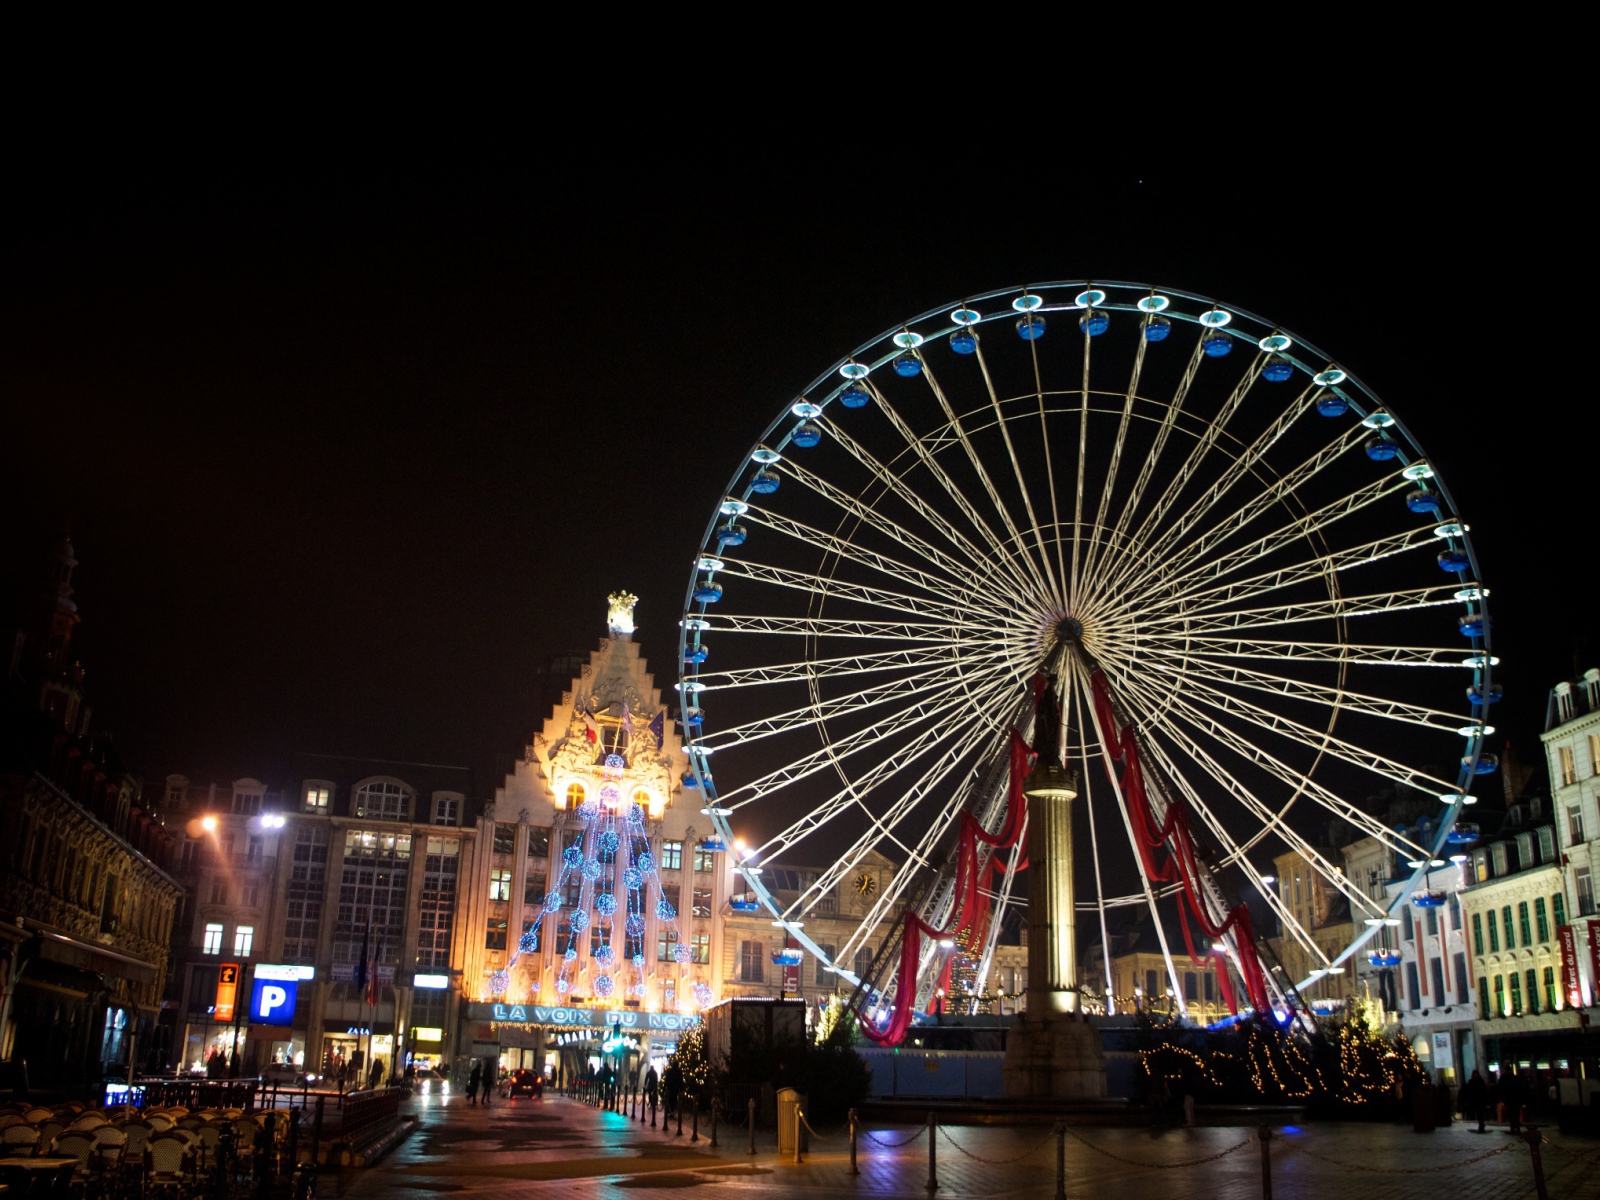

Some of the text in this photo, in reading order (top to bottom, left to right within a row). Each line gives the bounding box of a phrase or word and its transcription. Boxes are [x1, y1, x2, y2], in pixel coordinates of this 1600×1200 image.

[1563, 931, 1572, 951] nord
[1566, 954, 1574, 965] du
[1568, 967, 1577, 989] furet
[259, 985, 286, 1017] P
[494, 1005, 700, 1029] LA VOIX DU NOR
